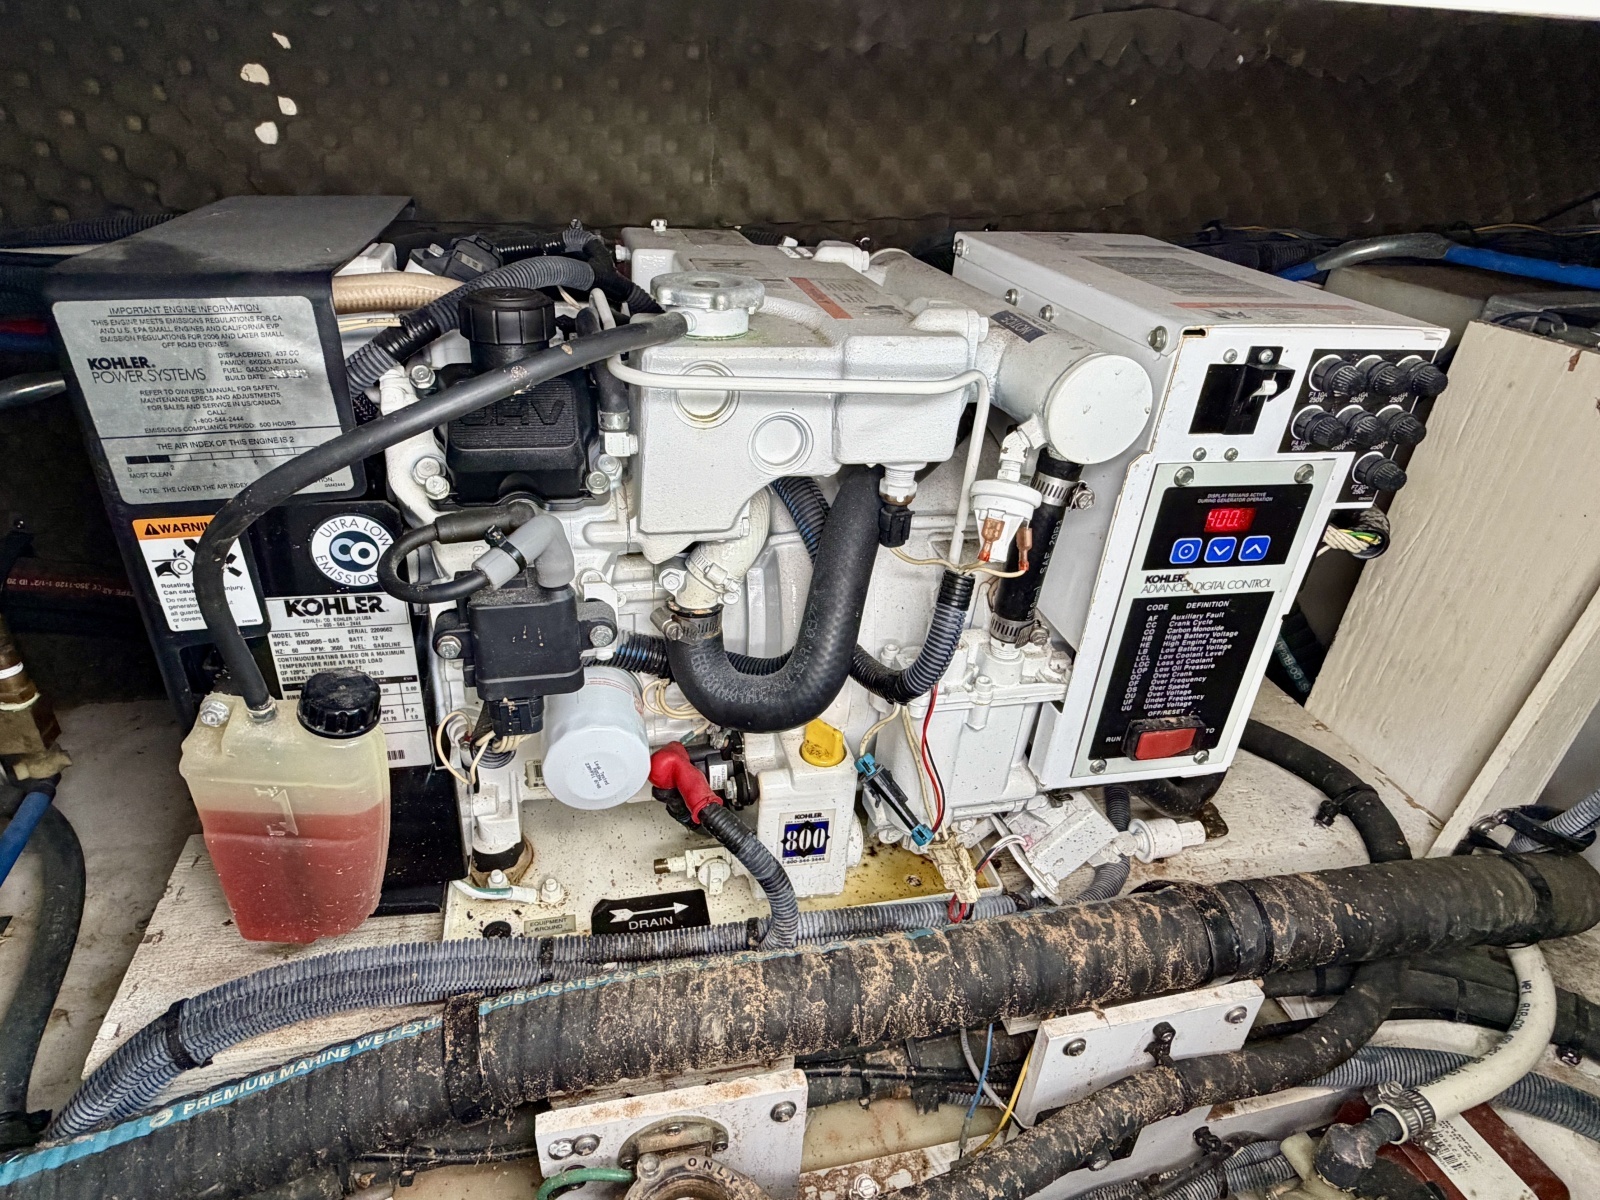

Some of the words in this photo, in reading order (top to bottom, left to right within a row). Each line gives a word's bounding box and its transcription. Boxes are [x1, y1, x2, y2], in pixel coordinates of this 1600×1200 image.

[109, 306, 161, 315] IMPORTANT
[164, 305, 196, 314] ENGINE
[198, 304, 260, 313] INFORMATION
[92, 370, 146, 383] POWER
[148, 368, 206, 382] SYSTEMS
[319, 518, 359, 538] ULTRA
[364, 522, 392, 546] LOW
[1141, 582, 1196, 594] ADVANCED
[1195, 580, 1225, 591] DIGITAL
[1228, 578, 1272, 589] CONTROL
[284, 596, 386, 617] KOHLER
[785, 828, 826, 851] 800
[530, 918, 567, 927] EQUIPMENT
[628, 916, 673, 930] DRAIN
[183, 1072, 275, 1114] PREMIUM
[280, 1046, 352, 1081] MARINE
[356, 1029, 398, 1053] WET
[688, 1158, 738, 1184] ONLY
